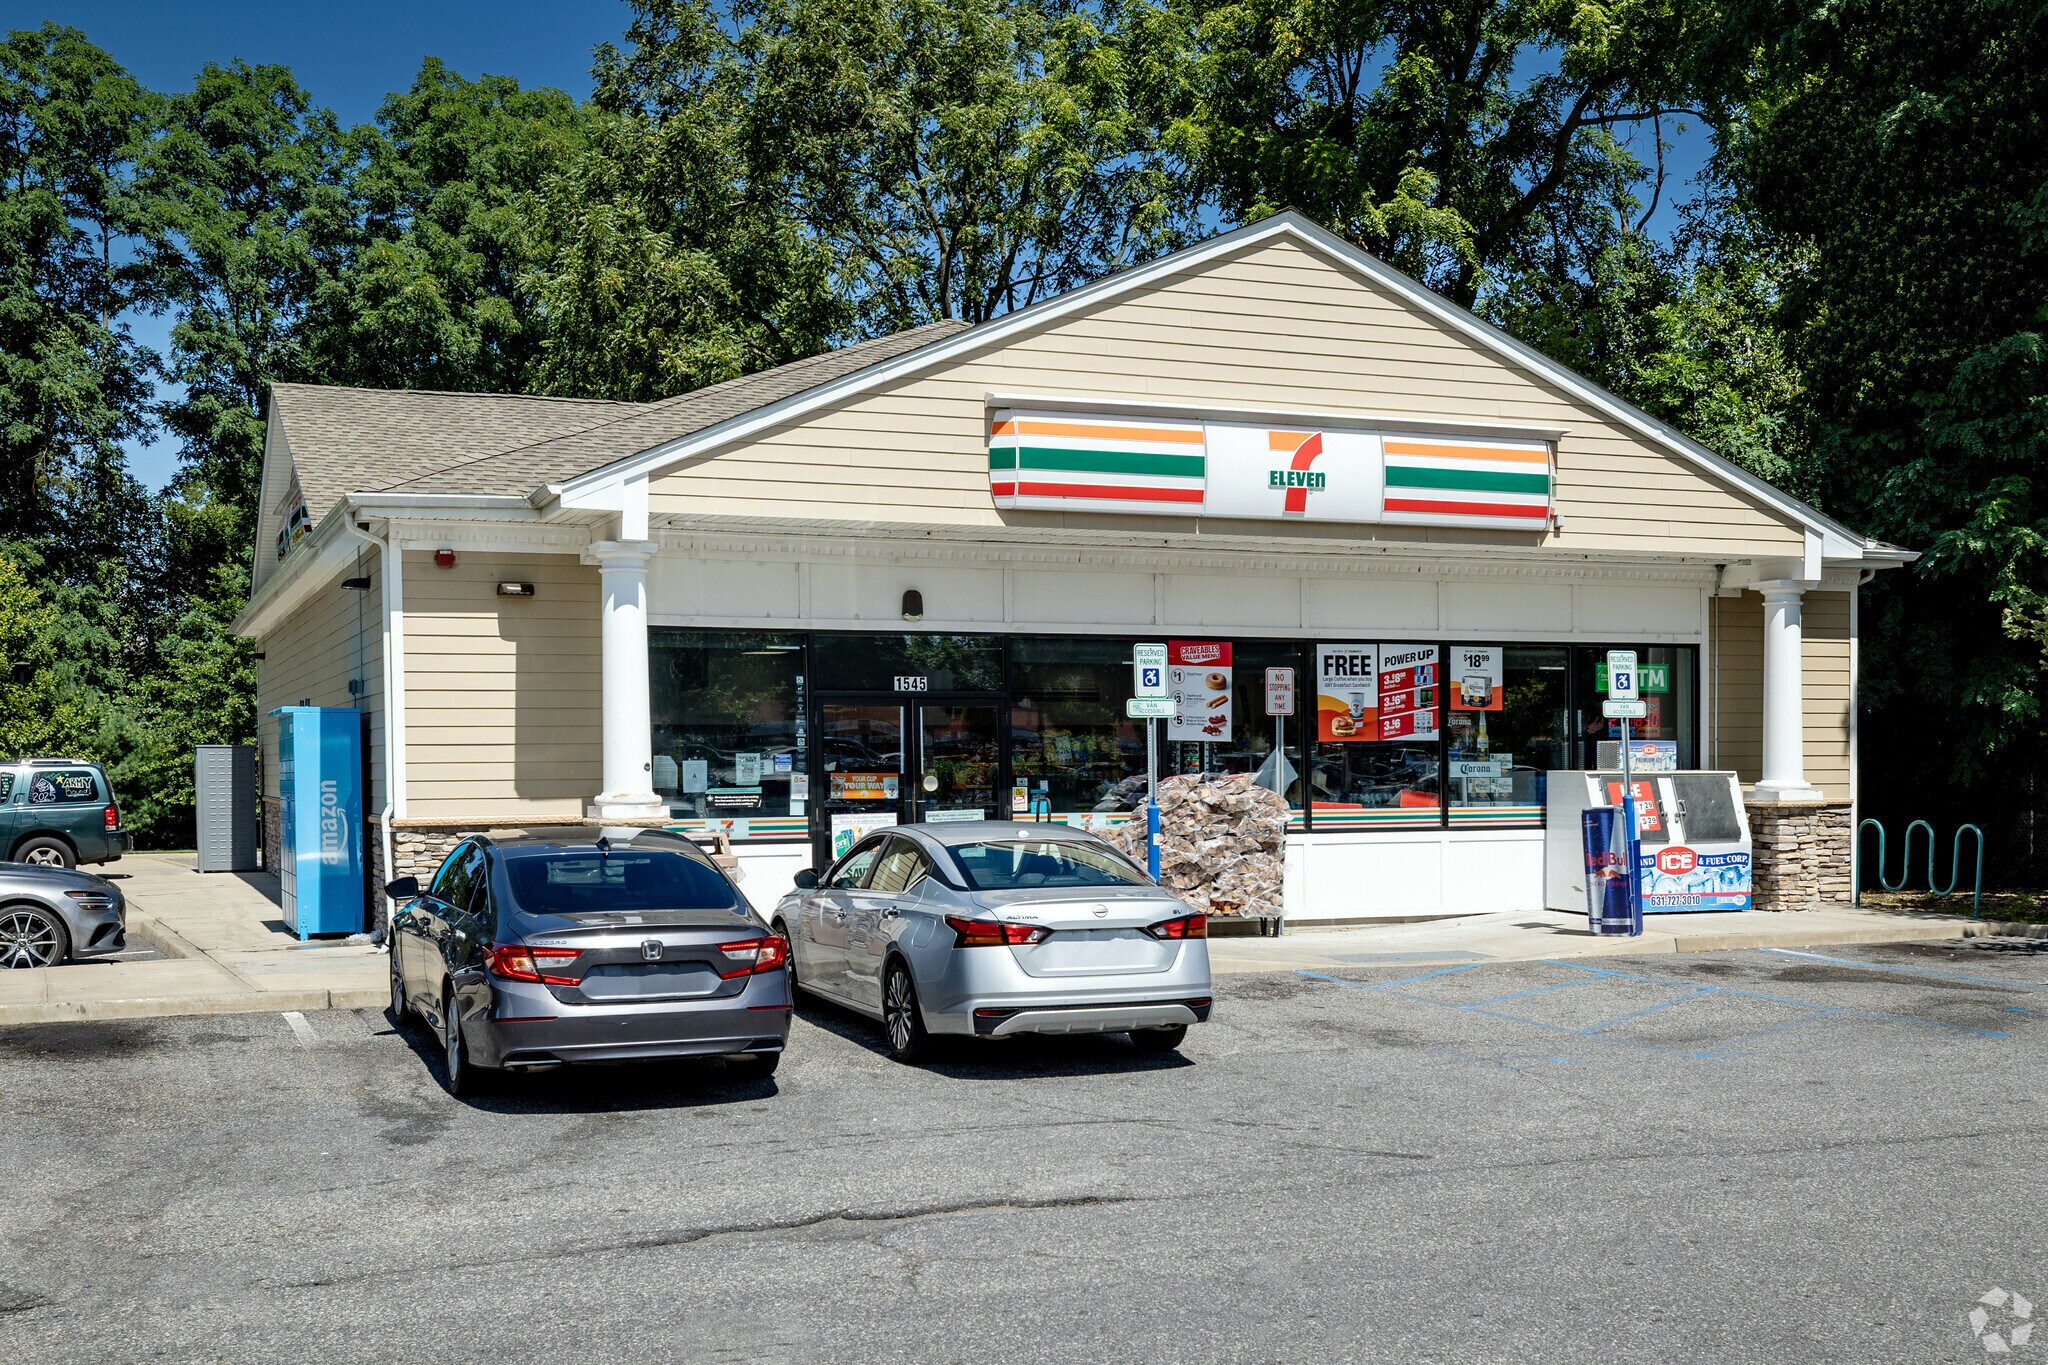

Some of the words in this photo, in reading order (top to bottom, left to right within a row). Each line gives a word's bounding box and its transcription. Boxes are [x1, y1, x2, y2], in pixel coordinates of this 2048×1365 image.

[1268, 431, 1322, 512] 7
[1137, 649, 1164, 657] RESERVED
[1180, 644, 1220, 655] CRAVEABLES
[1384, 652, 1416, 667] POWER
[1417, 649, 1434, 661] UP
[1323, 655, 1372, 676] FREE
[1612, 663, 1632, 671] PARKING
[1275, 673, 1285, 681] NO
[1637, 669, 1665, 688] TM
[896, 677, 926, 690] 1545
[1269, 683, 1291, 691] STOPPING
[1460, 763, 1491, 775] Corona
[61, 776, 93, 789] ARMY
[844, 782, 867, 790] YOUR
[867, 782, 885, 790] WAY
[321, 780, 338, 865] amazon
[1660, 852, 1693, 870] ICE
[1699, 857, 1705, 865] &
[1706, 857, 1725, 866] FUEL
[1726, 855, 1748, 864] CORP.
[847, 868, 869, 878] SAV
[1650, 895, 1700, 906] 631-727-3010
